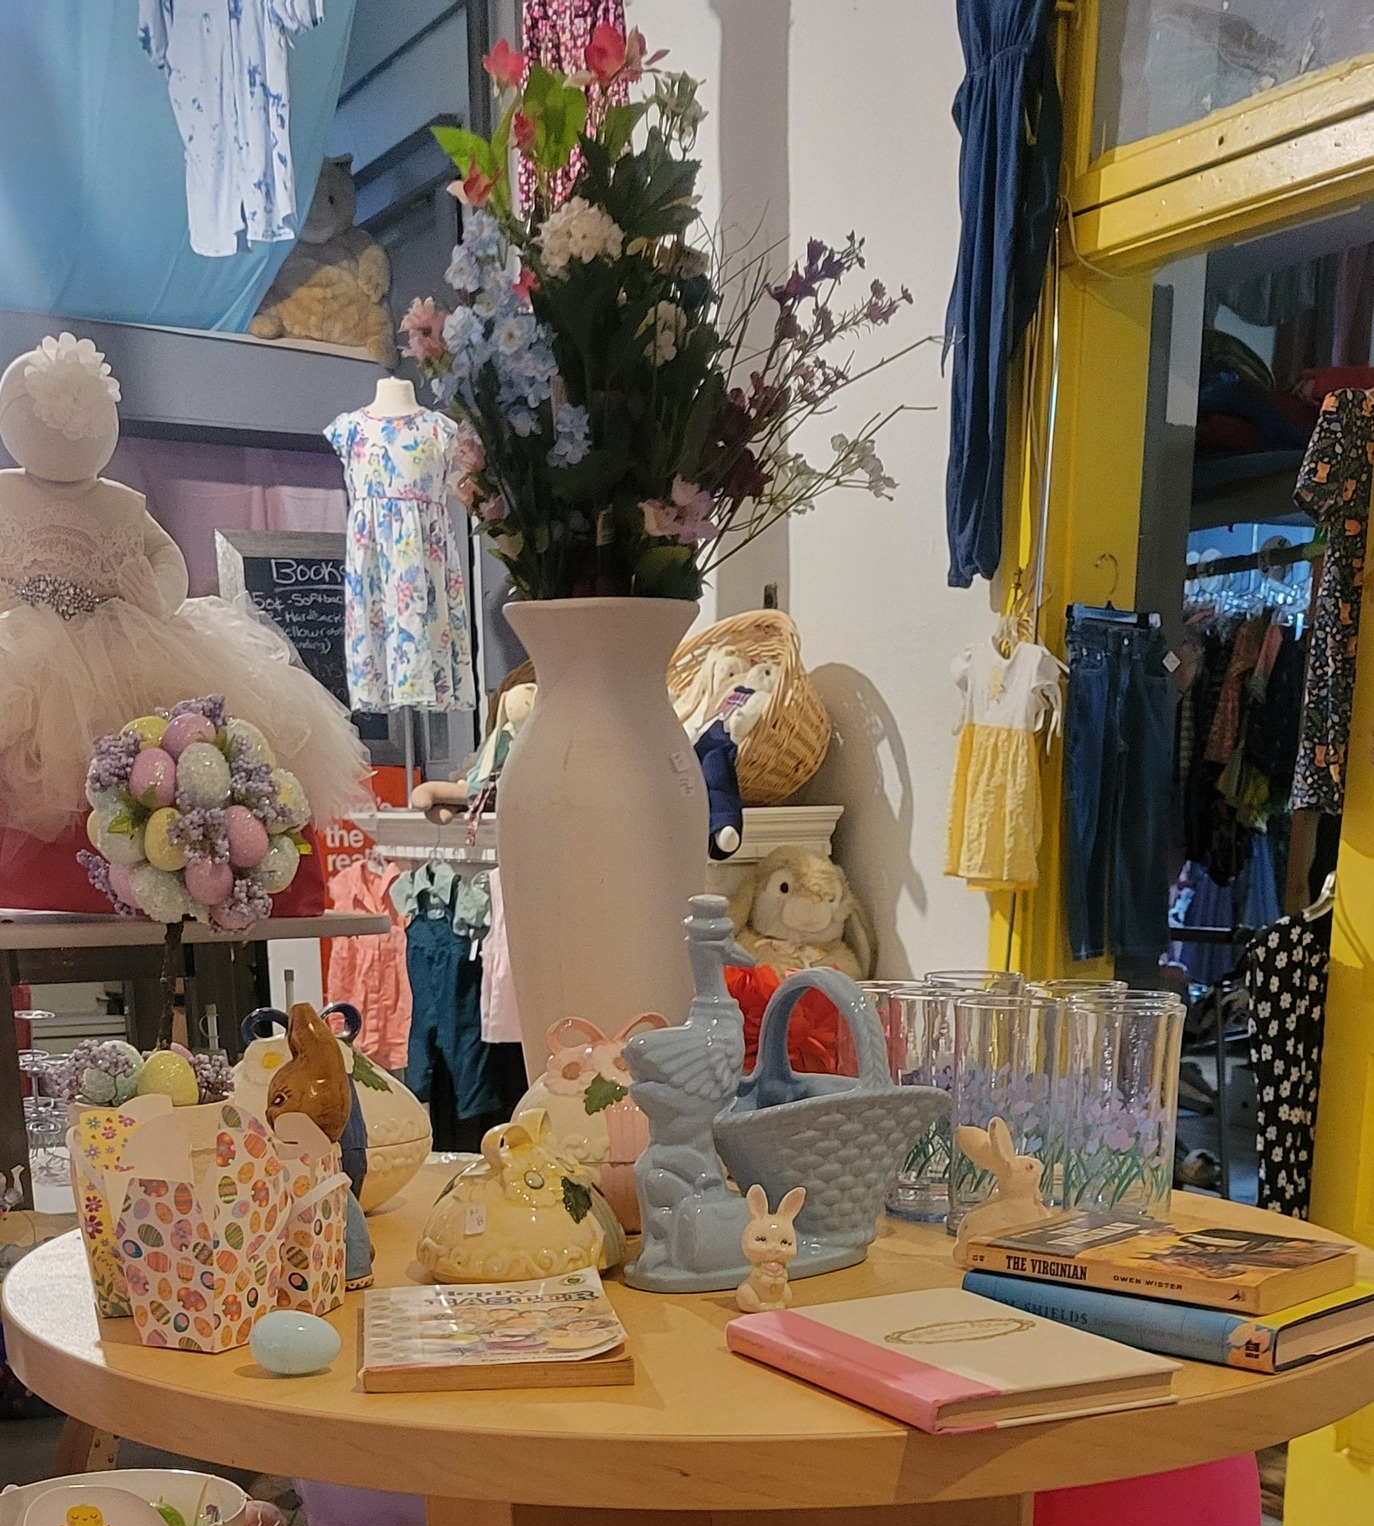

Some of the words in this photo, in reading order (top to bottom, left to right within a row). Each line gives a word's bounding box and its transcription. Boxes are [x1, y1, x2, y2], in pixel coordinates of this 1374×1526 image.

[325, 824, 365, 848] the
[326, 848, 371, 872] re
[1006, 1254, 1027, 1272] THE
[1031, 1258, 1088, 1281] VIRGINIAN
[1113, 1274, 1142, 1285] OWEN
[1145, 1278, 1183, 1291] WISTER
[1024, 1302, 1089, 1325] SHIELDS
